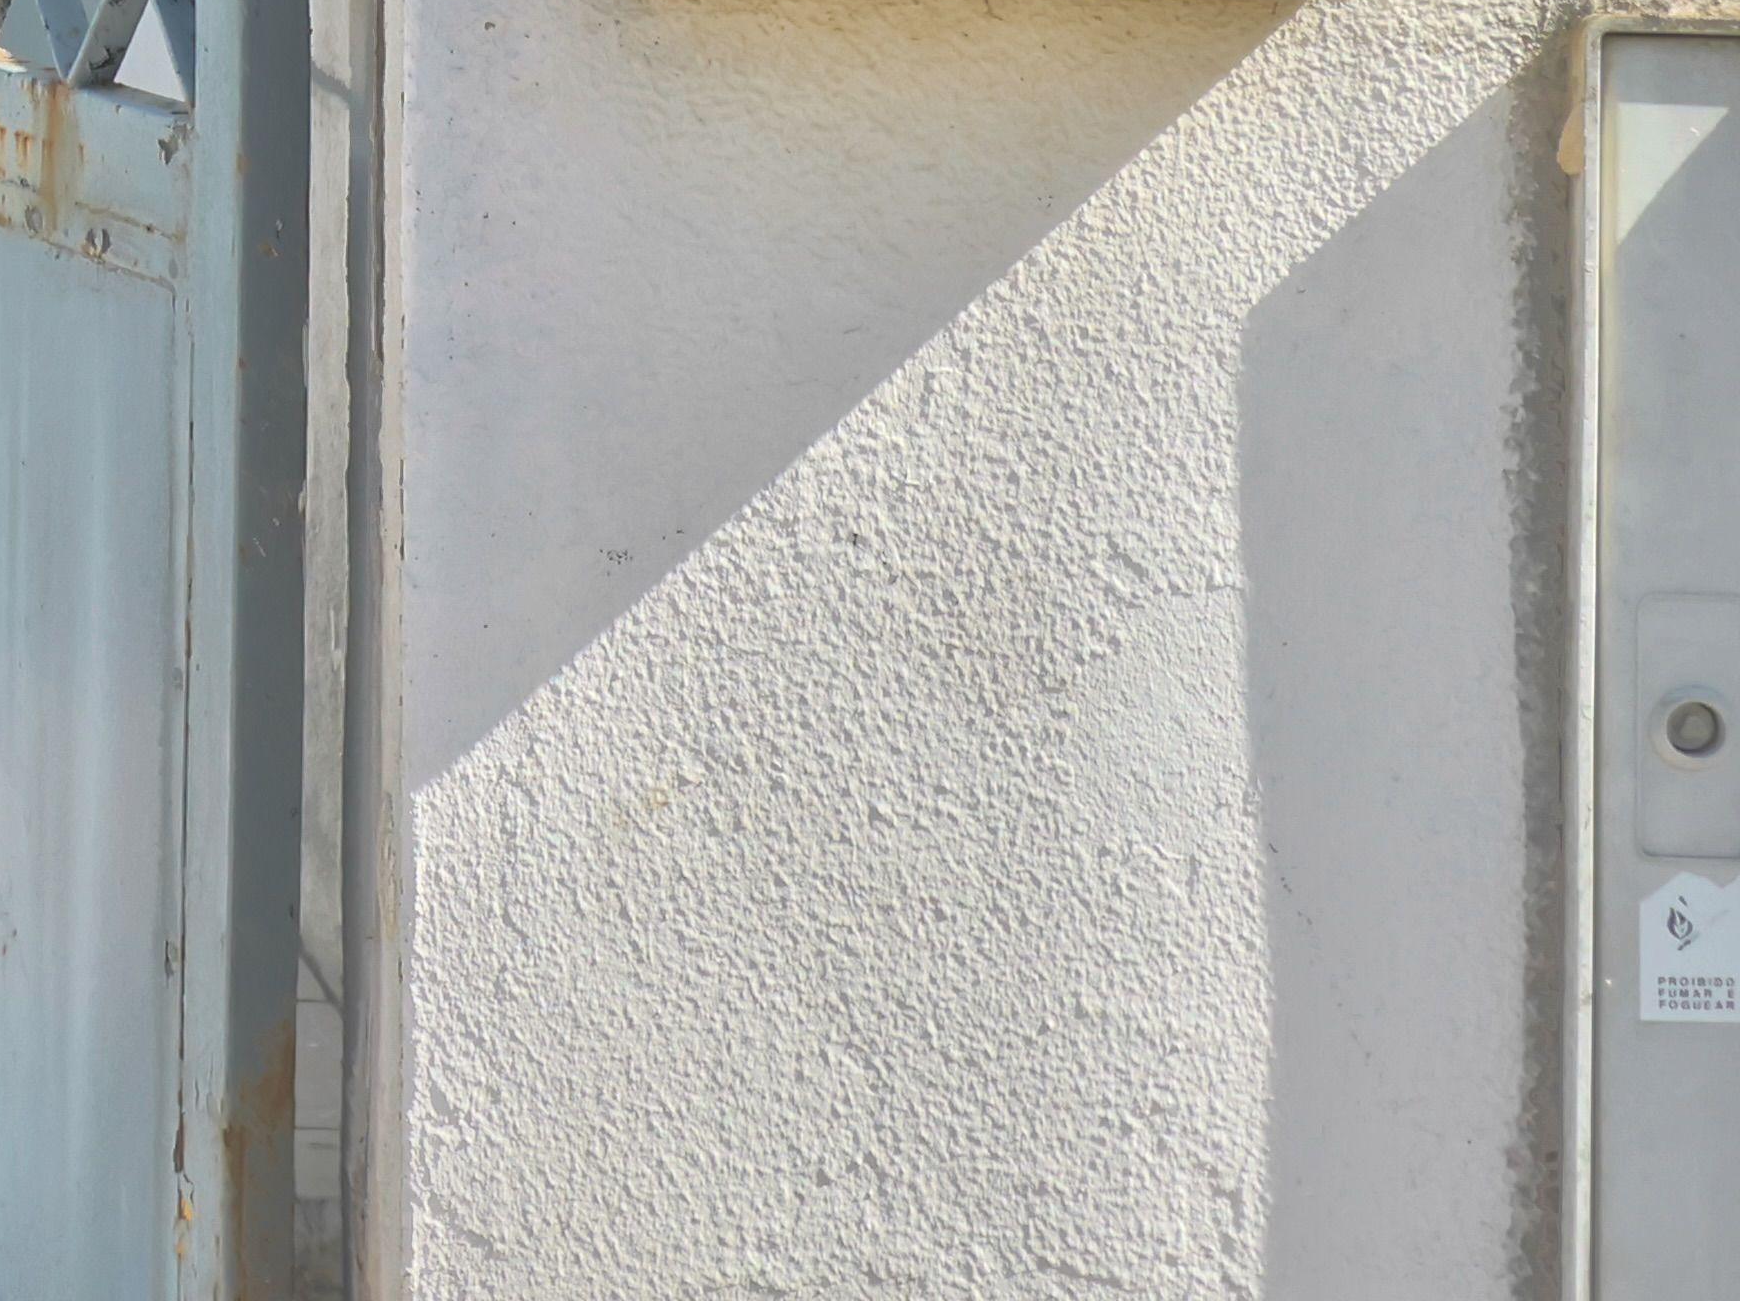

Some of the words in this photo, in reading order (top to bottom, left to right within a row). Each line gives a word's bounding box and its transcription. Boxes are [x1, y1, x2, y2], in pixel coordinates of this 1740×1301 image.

[1658, 976, 1735, 987] PROIBIDO
[1658, 988, 1712, 998] FUMAR
[1658, 999, 1735, 1010] FOGUEAR
